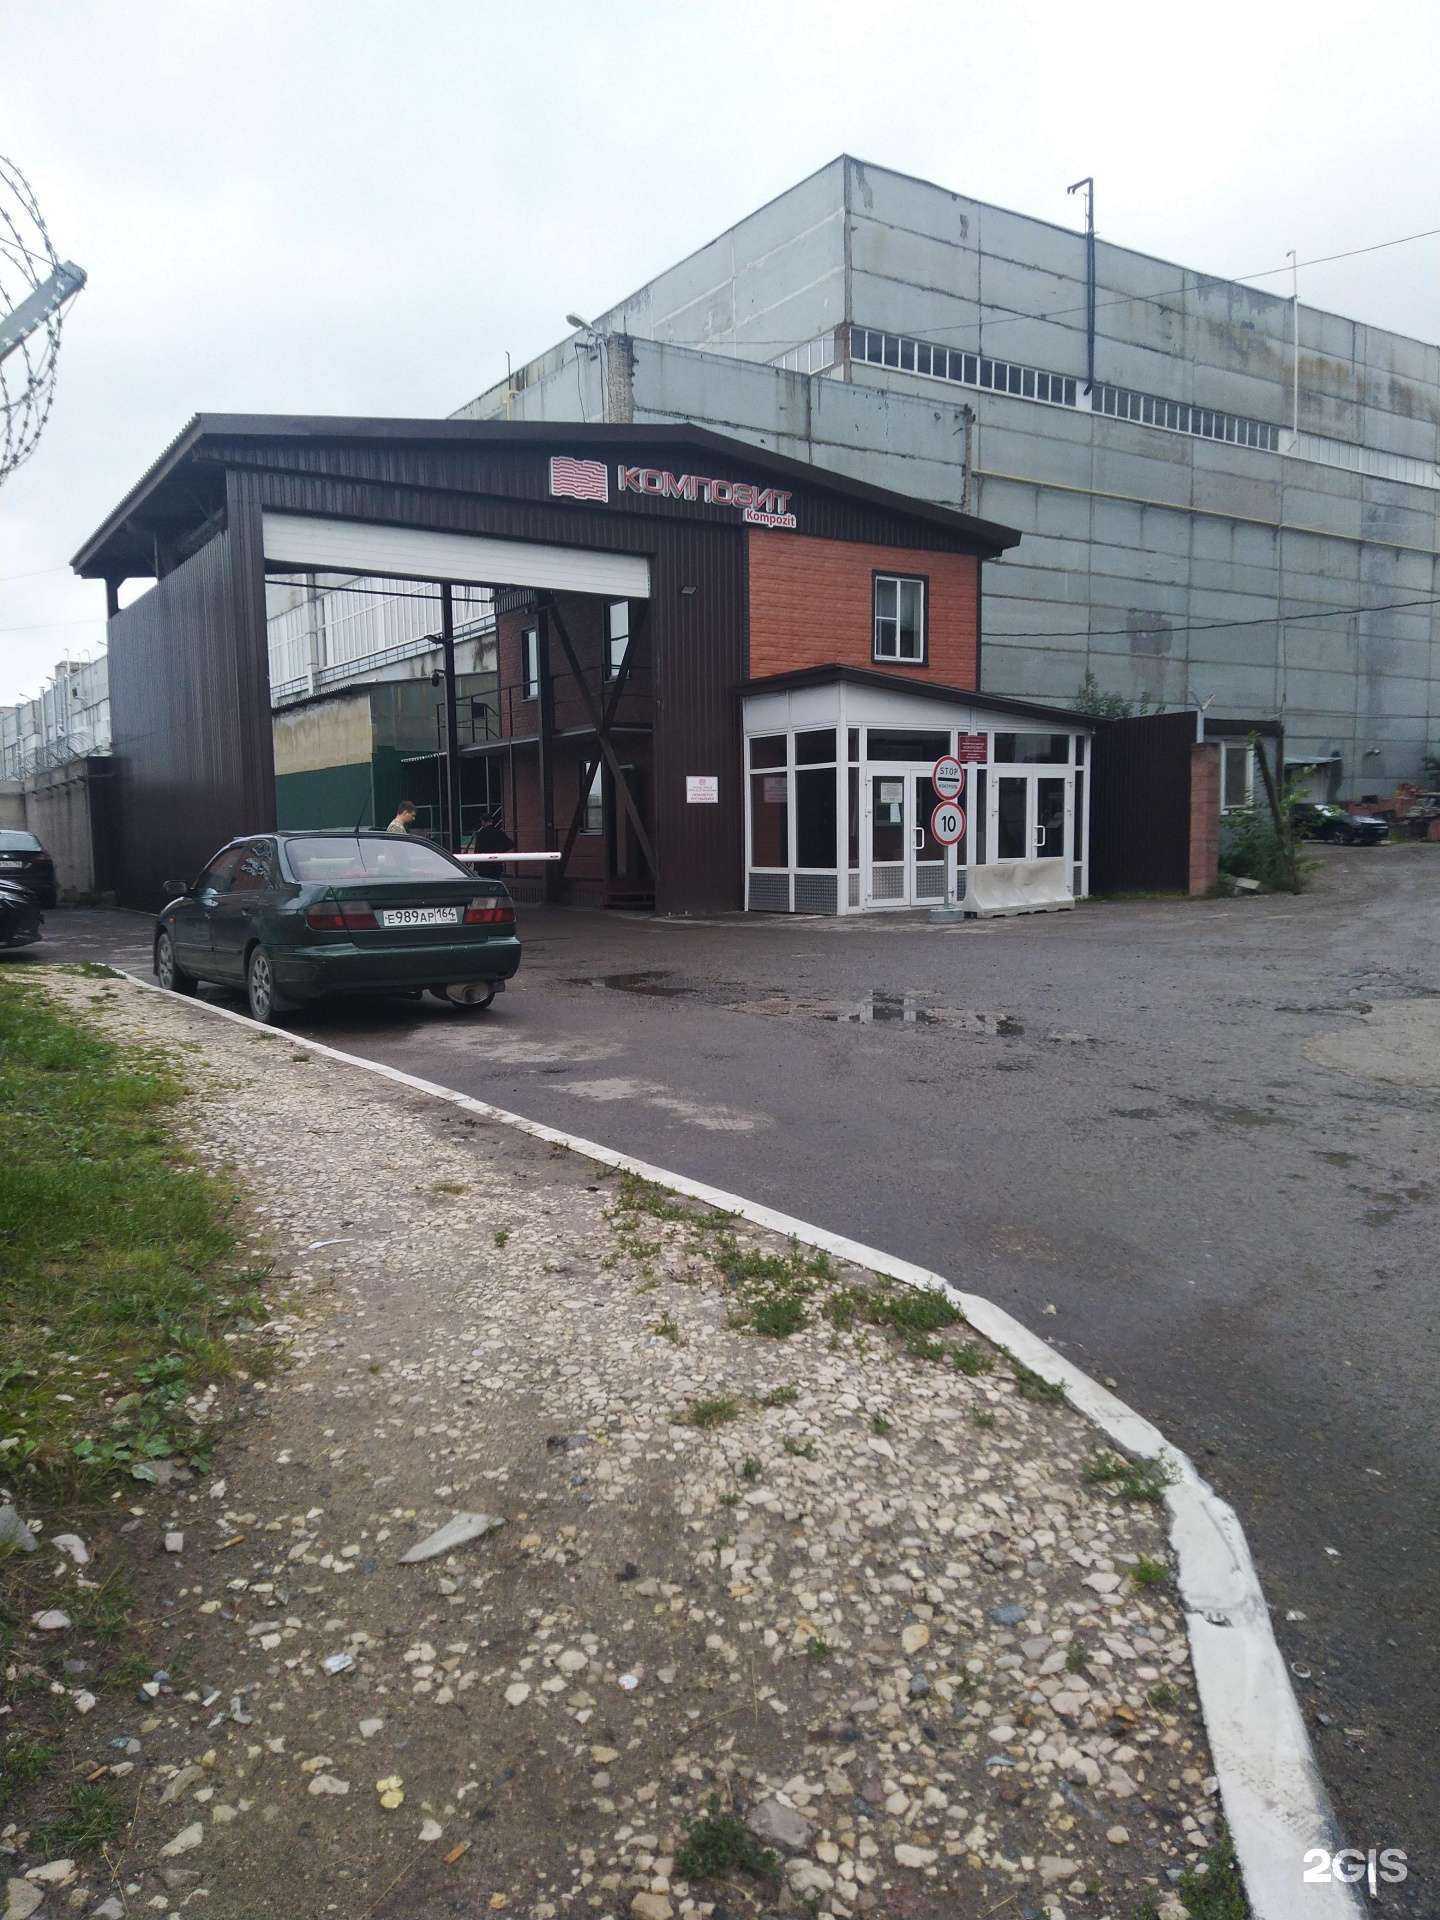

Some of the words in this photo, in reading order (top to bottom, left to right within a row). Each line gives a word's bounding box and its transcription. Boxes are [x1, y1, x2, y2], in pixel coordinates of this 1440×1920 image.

[617, 464, 792, 513] КОМПОЗИТ
[746, 509, 796, 527] Kompozit
[940, 767, 959, 776] STOP
[941, 815, 957, 832] 10
